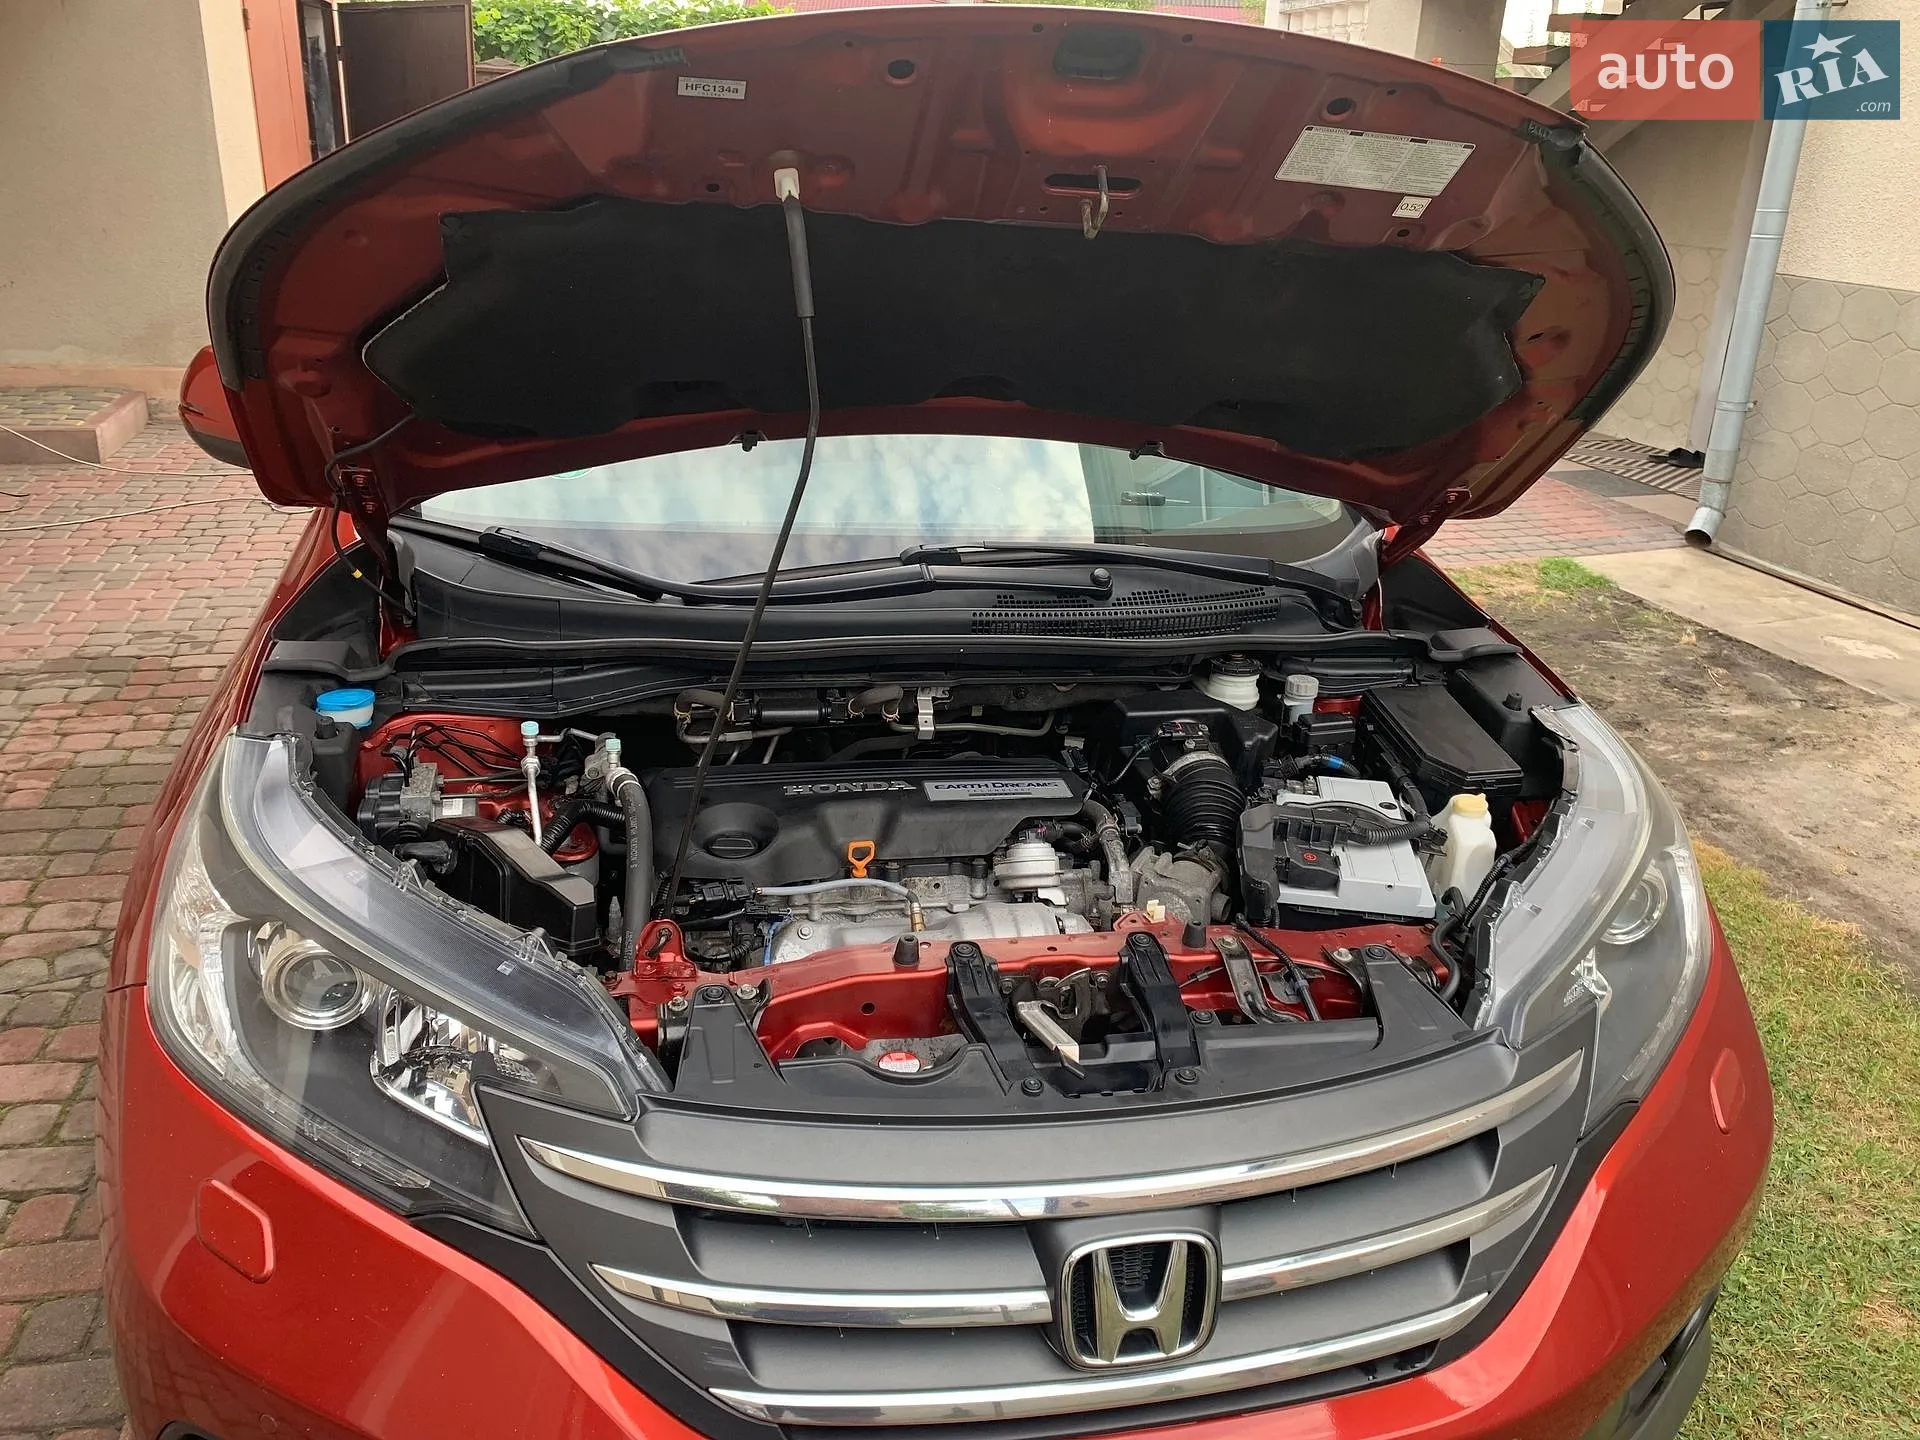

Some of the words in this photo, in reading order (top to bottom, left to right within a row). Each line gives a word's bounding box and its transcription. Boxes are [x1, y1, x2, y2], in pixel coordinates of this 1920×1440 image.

[685, 82, 739, 94] HFC134a
[1400, 203, 1424, 212] 0.52
[783, 780, 917, 795] HONDA
